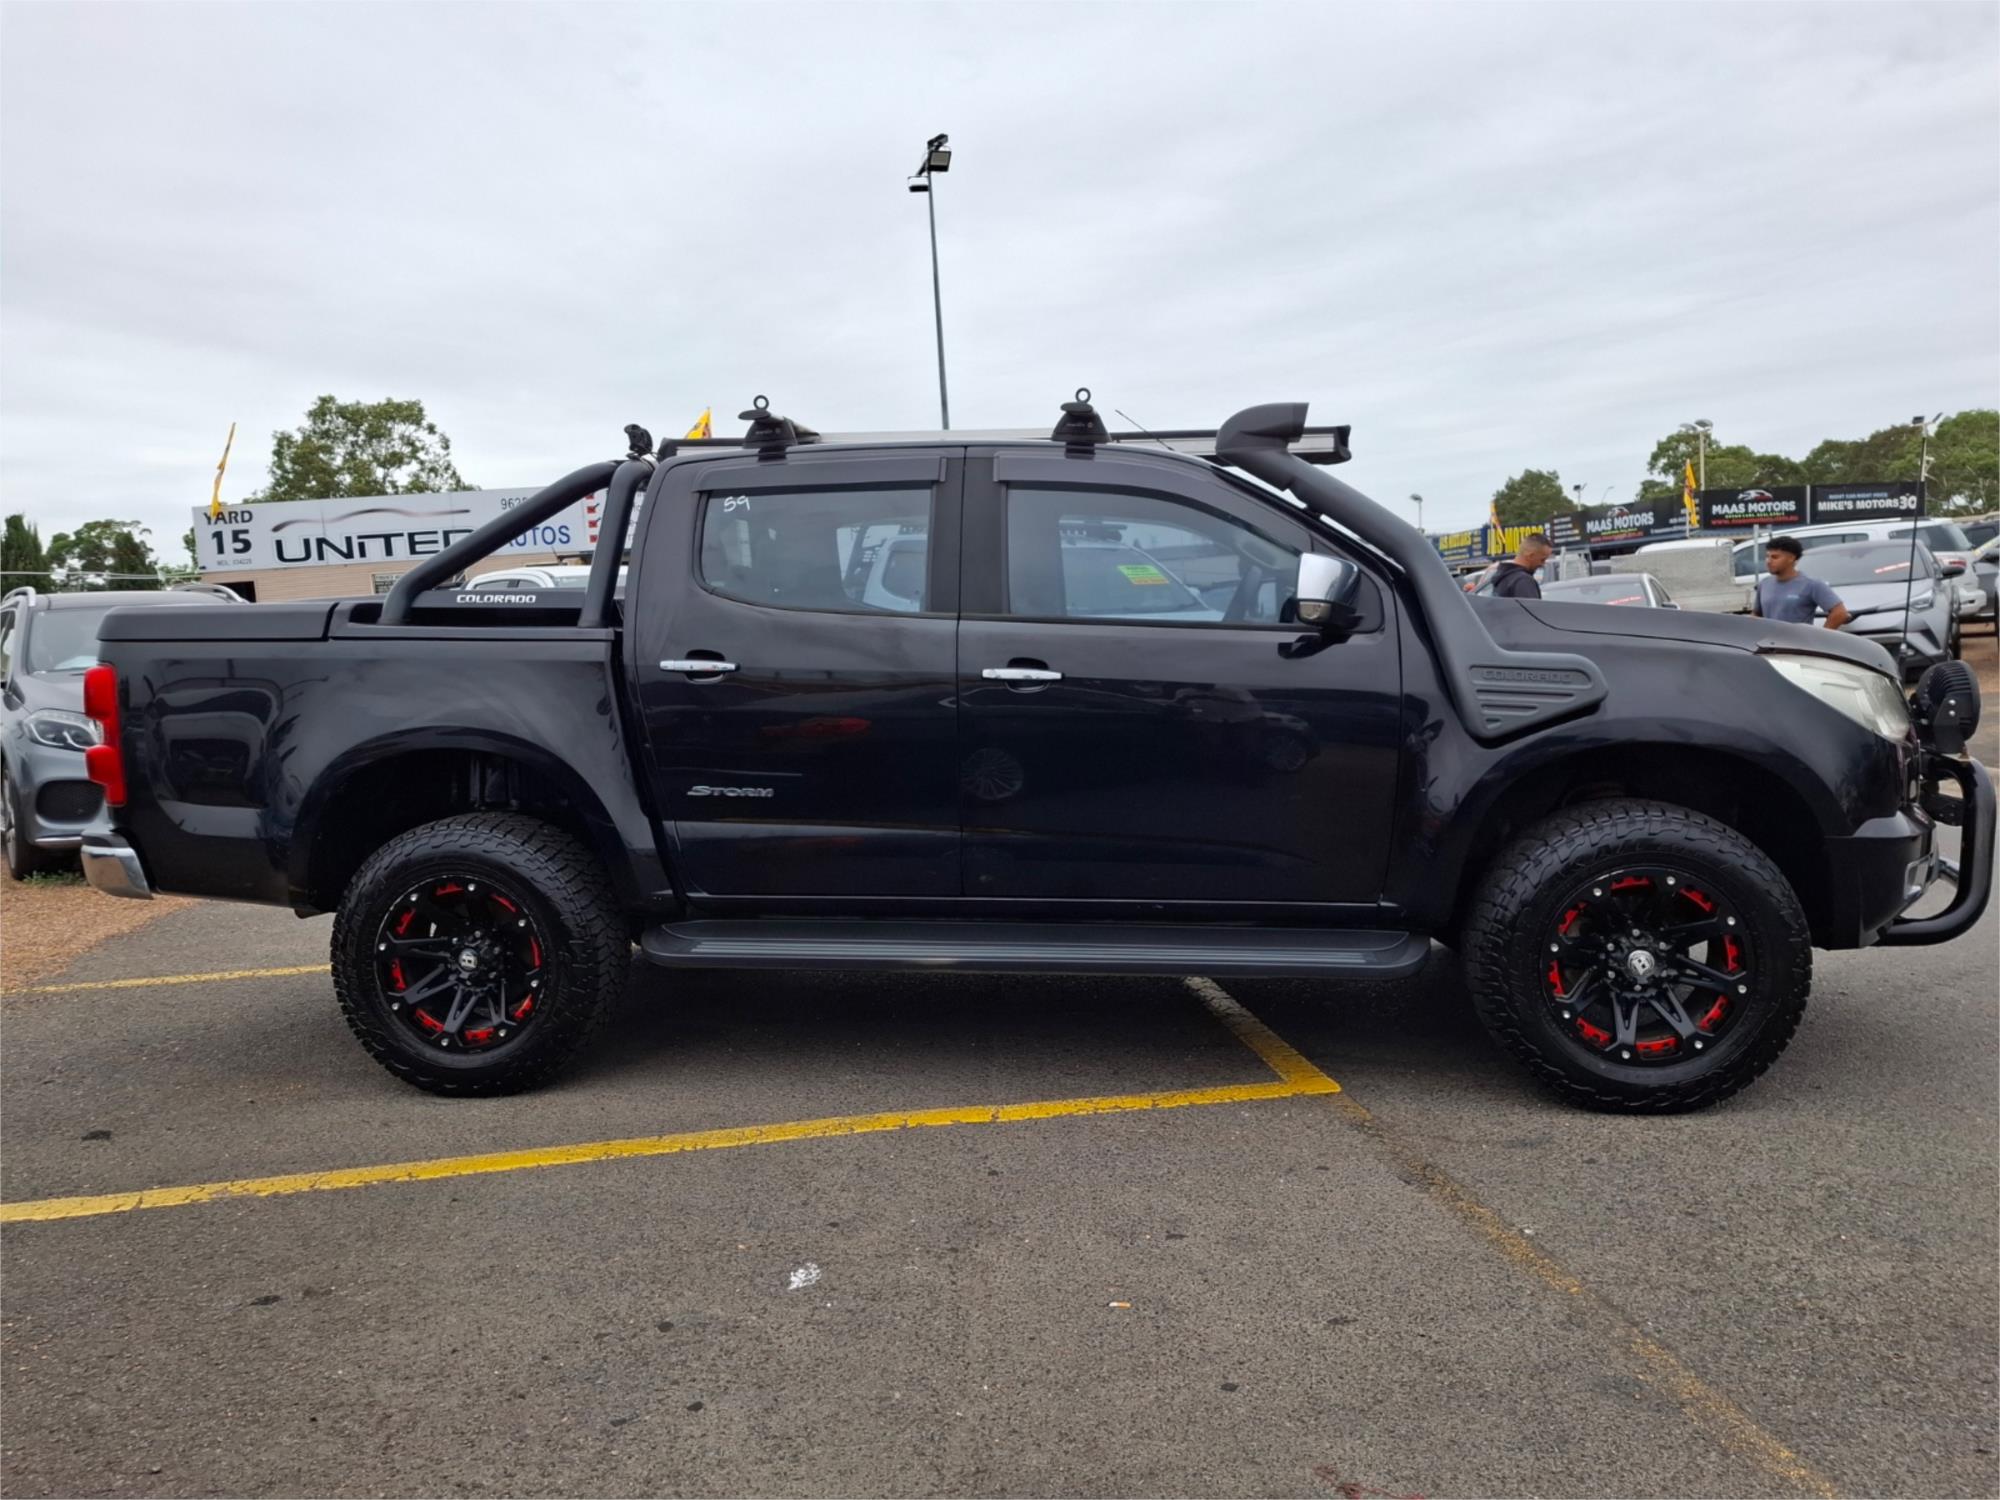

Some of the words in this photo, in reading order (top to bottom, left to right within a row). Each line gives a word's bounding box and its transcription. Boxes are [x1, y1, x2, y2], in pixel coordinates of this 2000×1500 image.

[724, 496, 750, 512] 59
[1712, 504, 1745, 515] MAAS
[1748, 501, 1796, 512] MOTORS
[1818, 501, 1853, 511] MIKE'S
[1856, 499, 1899, 509] MOTORS
[203, 510, 253, 525] YARD
[1586, 519, 1612, 533] MAAS
[1614, 512, 1654, 528] MOTORS
[212, 529, 252, 555] 15
[509, 525, 570, 547] UTOS
[1505, 525, 1544, 553] MOT
[457, 594, 536, 604] COLORADO
[1482, 670, 1572, 684] COLORADO
